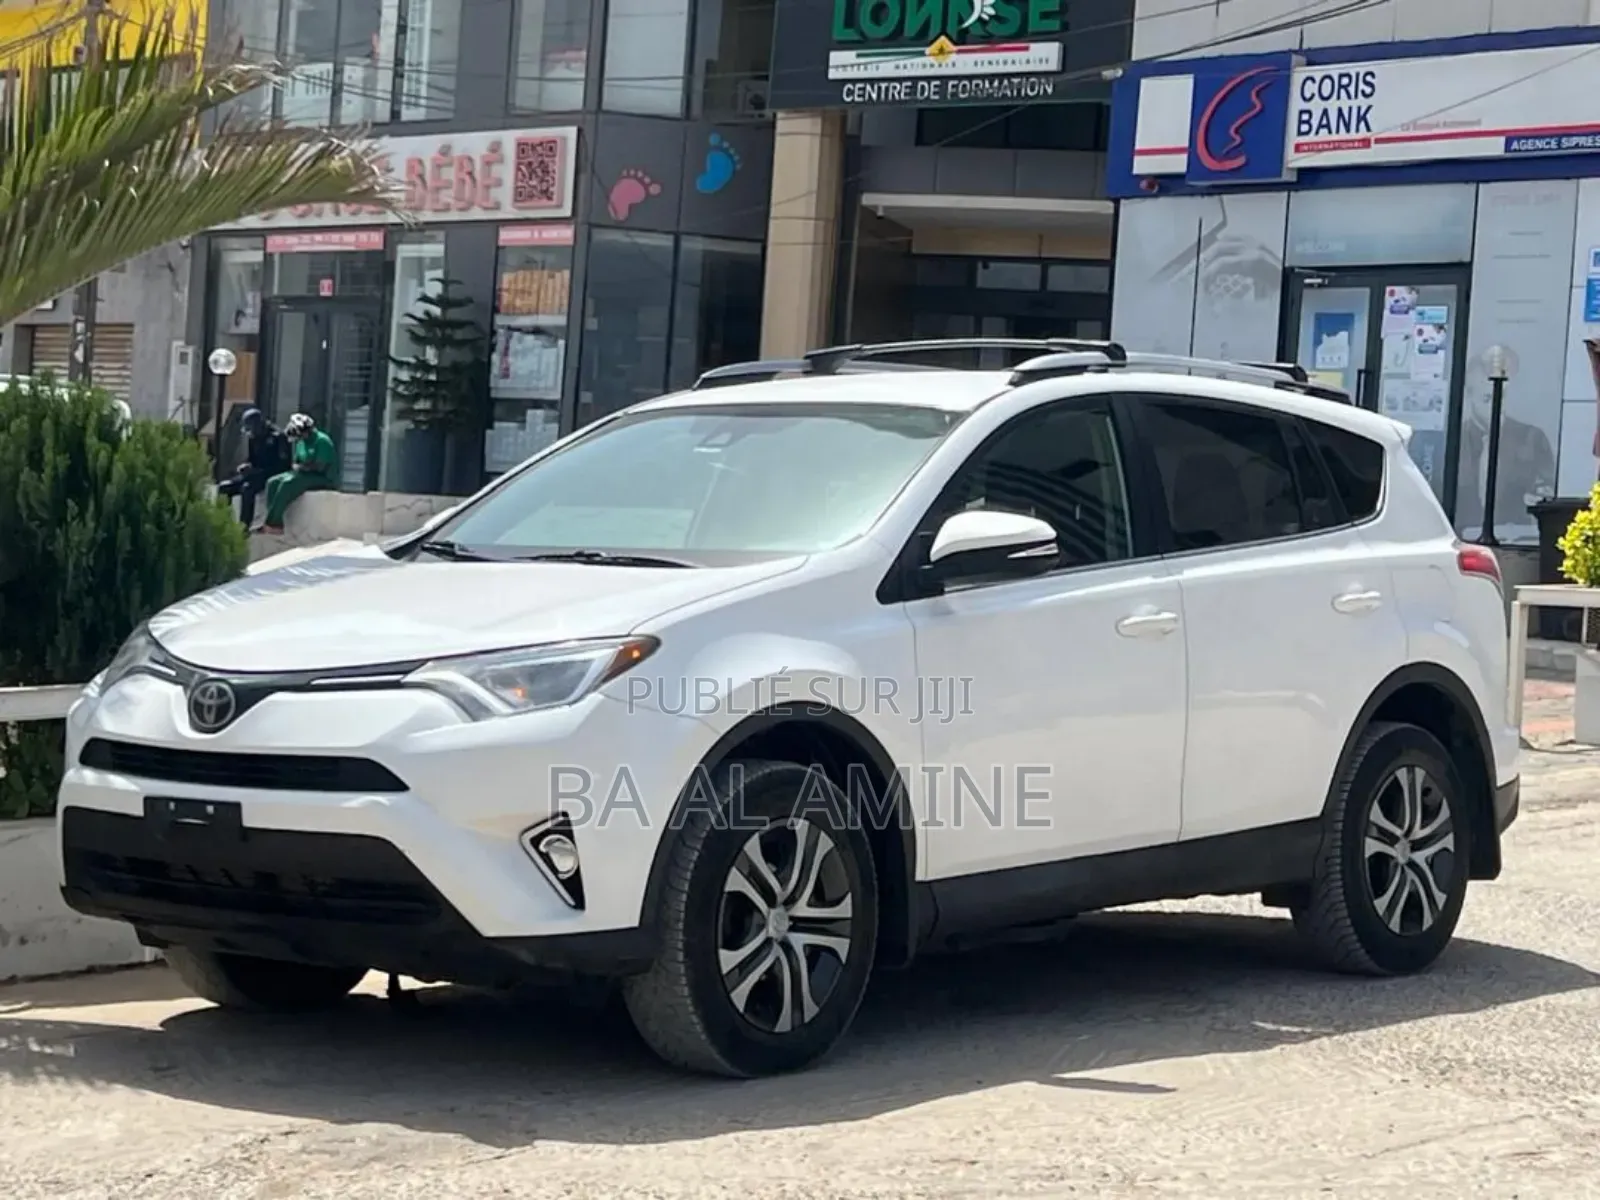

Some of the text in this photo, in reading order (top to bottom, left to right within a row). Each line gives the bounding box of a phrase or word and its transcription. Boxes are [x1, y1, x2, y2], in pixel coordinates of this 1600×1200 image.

[842, 77, 1054, 102] CENTRE DE FORMATION
[1300, 71, 1376, 102] CORIS
[1298, 105, 1374, 137] BANK
[1510, 137, 1560, 151] AGENCE
[404, 141, 504, 213] BÉBÉ
